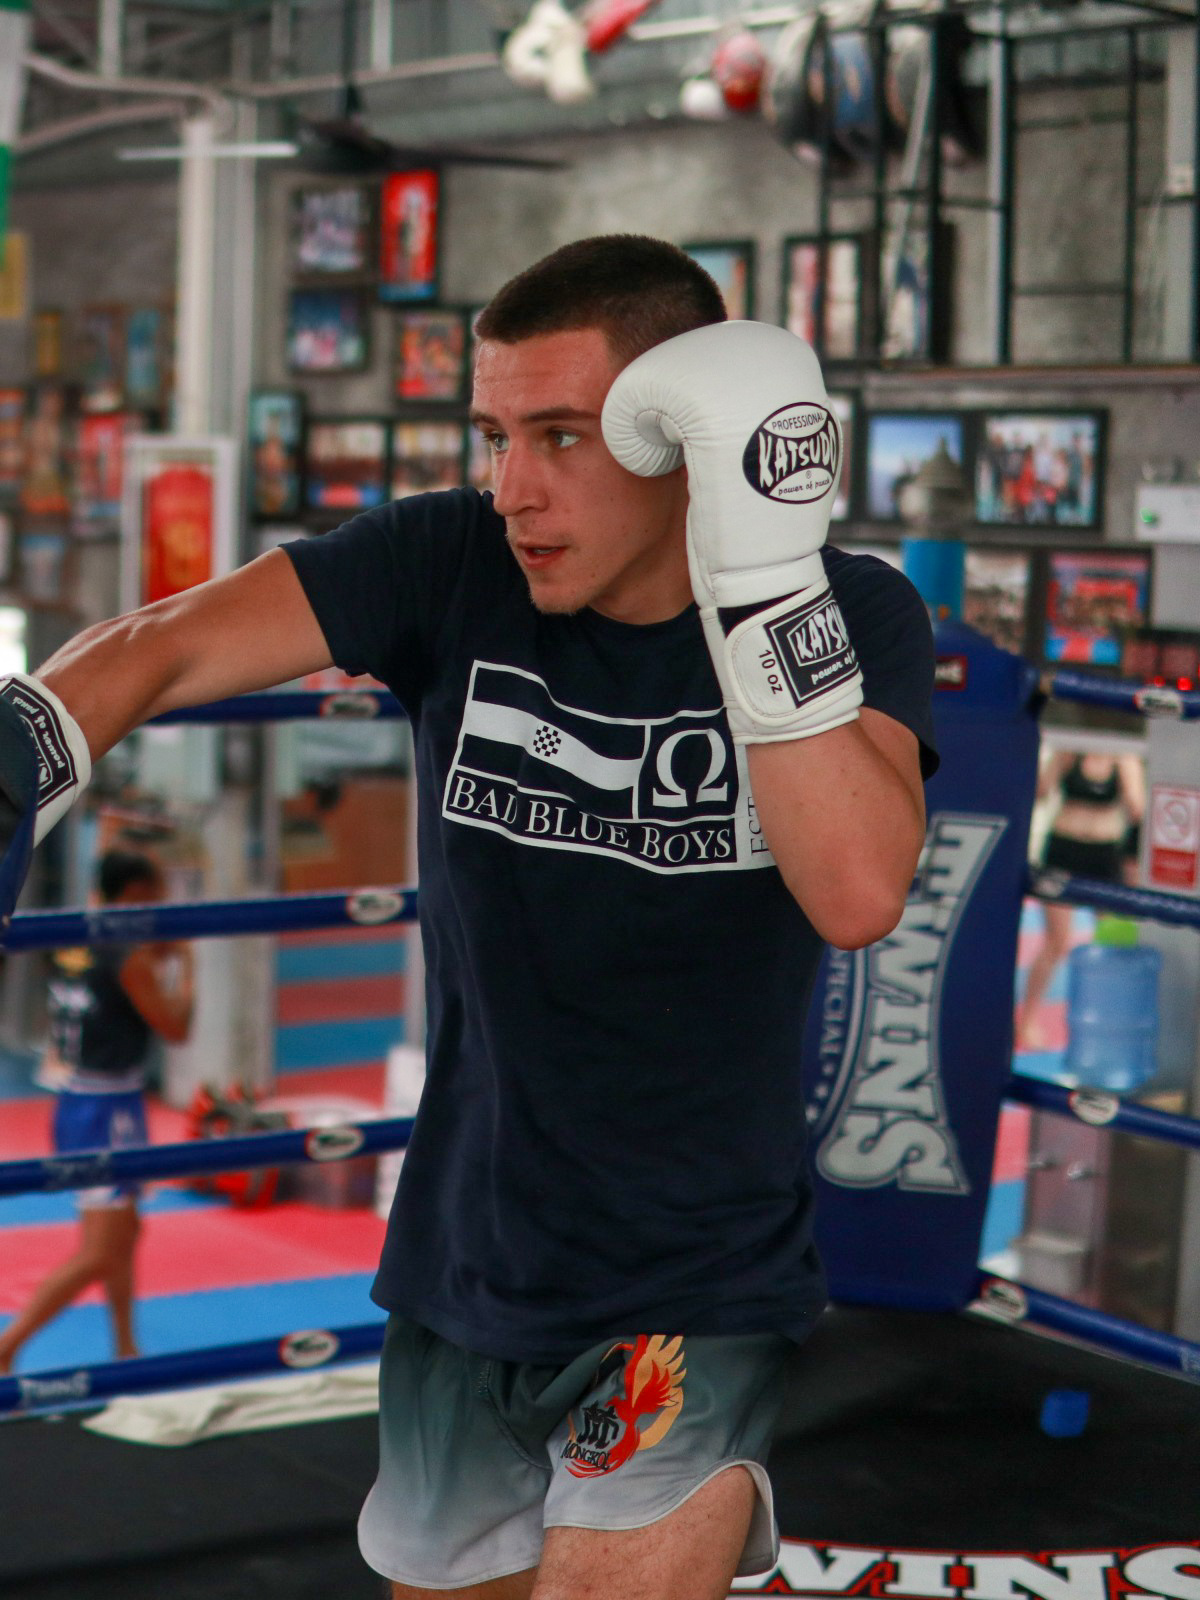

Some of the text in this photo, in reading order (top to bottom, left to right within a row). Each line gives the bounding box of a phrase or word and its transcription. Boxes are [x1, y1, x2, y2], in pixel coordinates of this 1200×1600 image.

[771, 411, 824, 430] PROFESSIONAL
[758, 420, 837, 489] KATSUDO
[778, 484, 803, 496] power
[805, 481, 813, 491] of
[758, 648, 777, 670] 10
[810, 661, 843, 686] power
[41, 731, 66, 770] power
[449, 775, 732, 864] BAD BLUE BOYS
